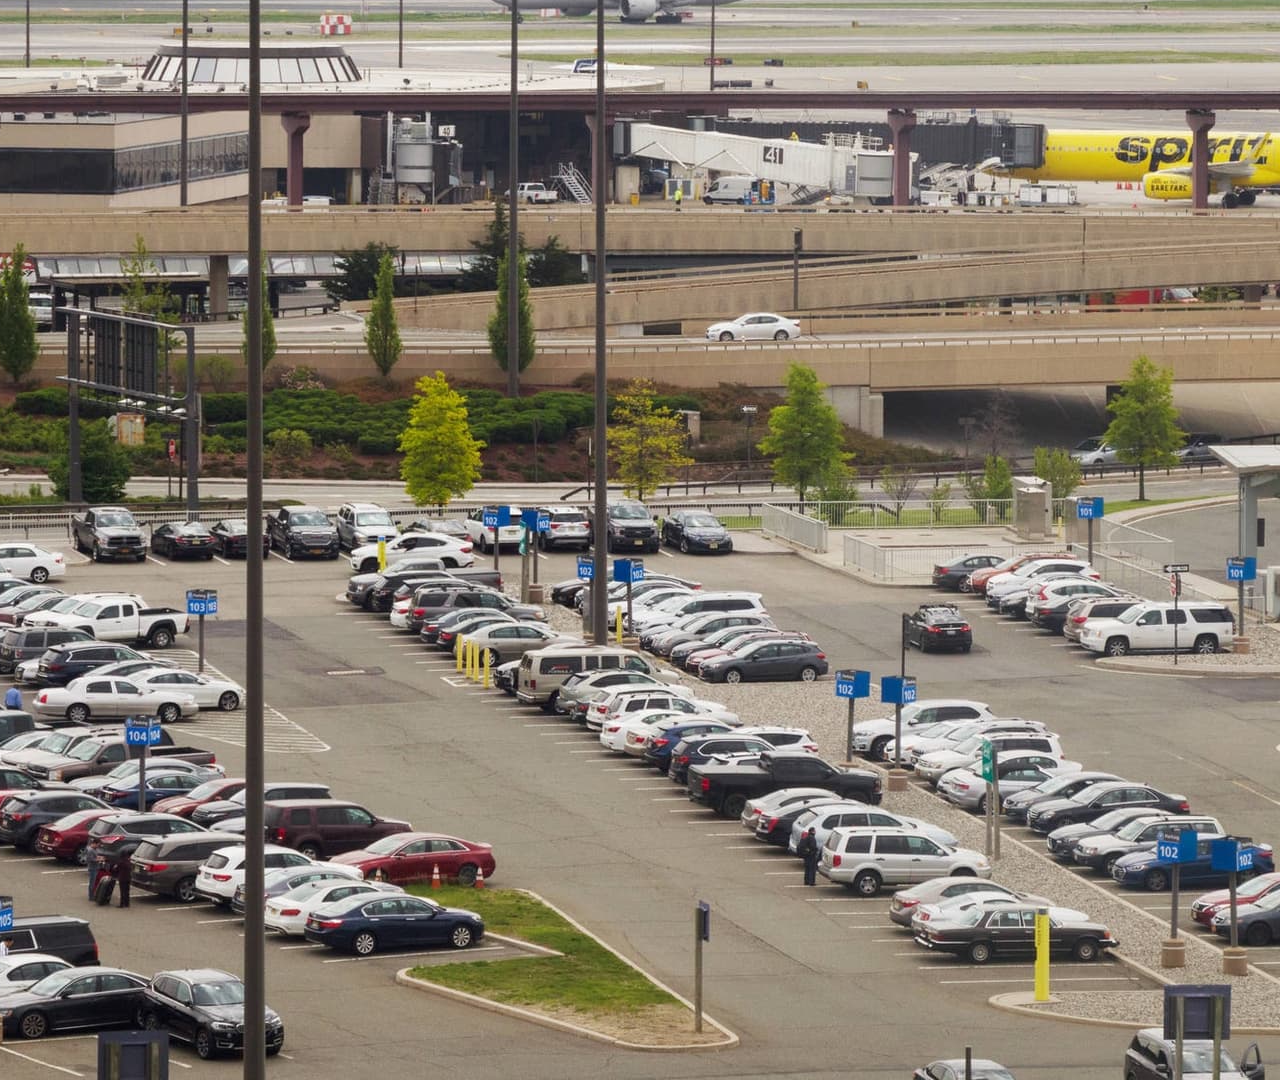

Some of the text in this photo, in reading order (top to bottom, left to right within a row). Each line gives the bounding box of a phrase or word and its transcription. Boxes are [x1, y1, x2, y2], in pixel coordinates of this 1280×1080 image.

[443, 127, 450, 135] 40
[765, 147, 780, 163] 41
[1115, 136, 1272, 172] sprit
[1080, 508, 1092, 516] 101
[485, 517, 498, 525] 102
[540, 520, 548, 529] 102
[580, 567, 592, 575] 102
[633, 570, 642, 579] 102
[1230, 569, 1243, 577] 101
[190, 603, 205, 611] 103
[838, 684, 853, 695] 102
[904, 690, 915, 700] 102
[129, 731, 147, 741] 104
[150, 730, 160, 740] 104
[1160, 846, 1178, 858] 102
[1240, 854, 1252, 865] 102
[0, 915, 11, 927] 105
